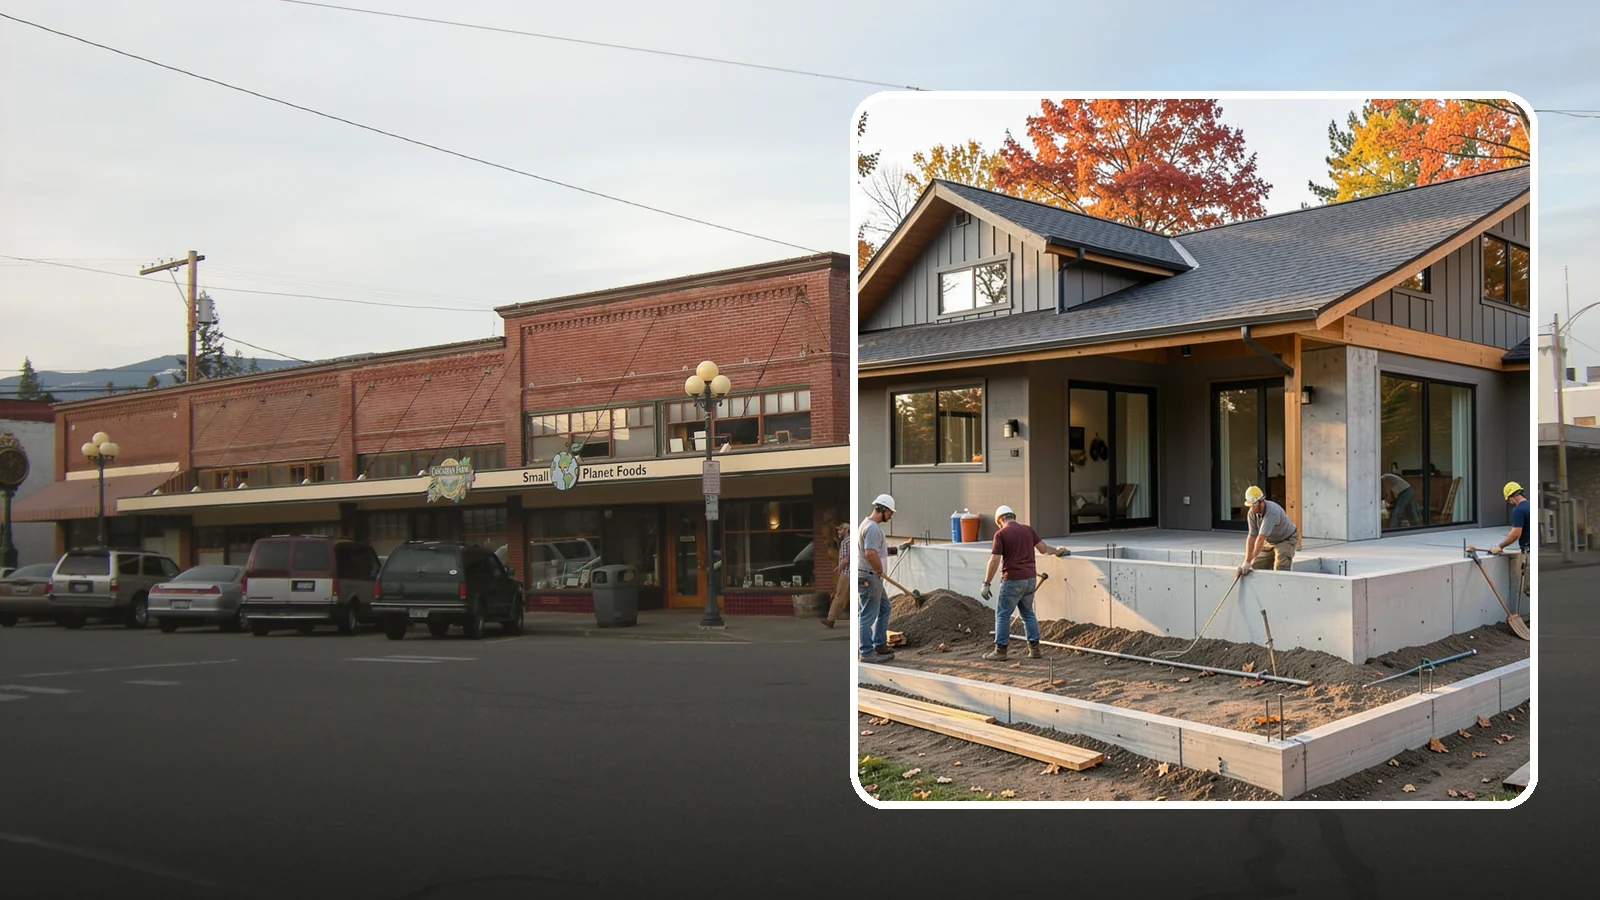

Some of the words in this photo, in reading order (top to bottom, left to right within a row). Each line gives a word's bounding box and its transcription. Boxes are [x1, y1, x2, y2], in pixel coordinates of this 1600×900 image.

[523, 471, 549, 482] Small
[583, 468, 614, 479] Planet
[617, 464, 647, 476] Foods
